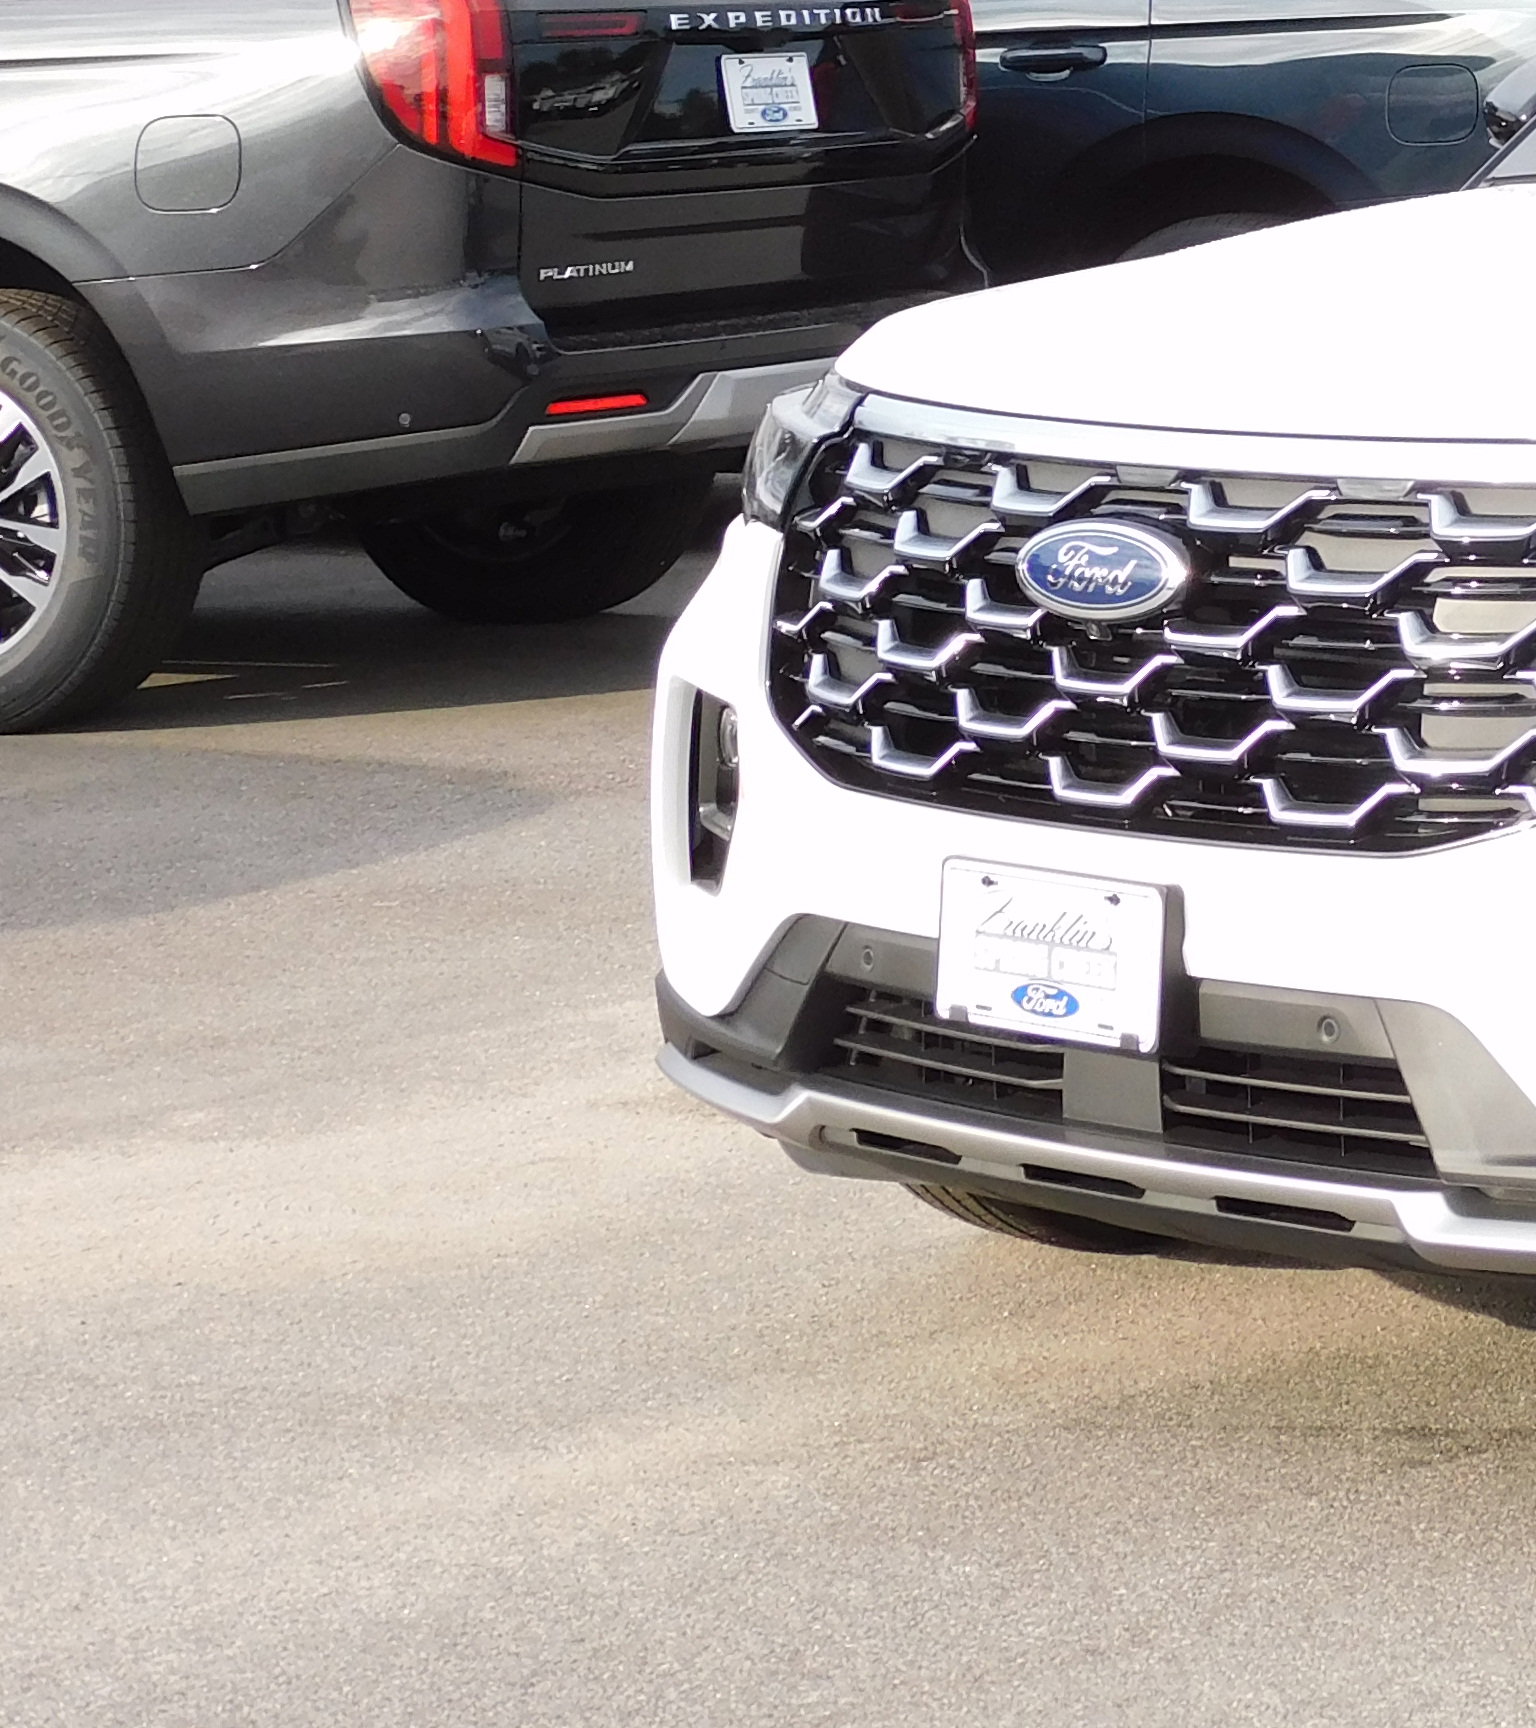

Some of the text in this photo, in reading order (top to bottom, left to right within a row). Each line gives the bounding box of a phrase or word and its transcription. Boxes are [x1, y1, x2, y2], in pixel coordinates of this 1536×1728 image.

[669, 7, 882, 31] EXPEDITION
[539, 260, 634, 281] PLATINUM
[1047, 540, 1138, 596] Ford
[1022, 984, 1069, 1016] Ford
